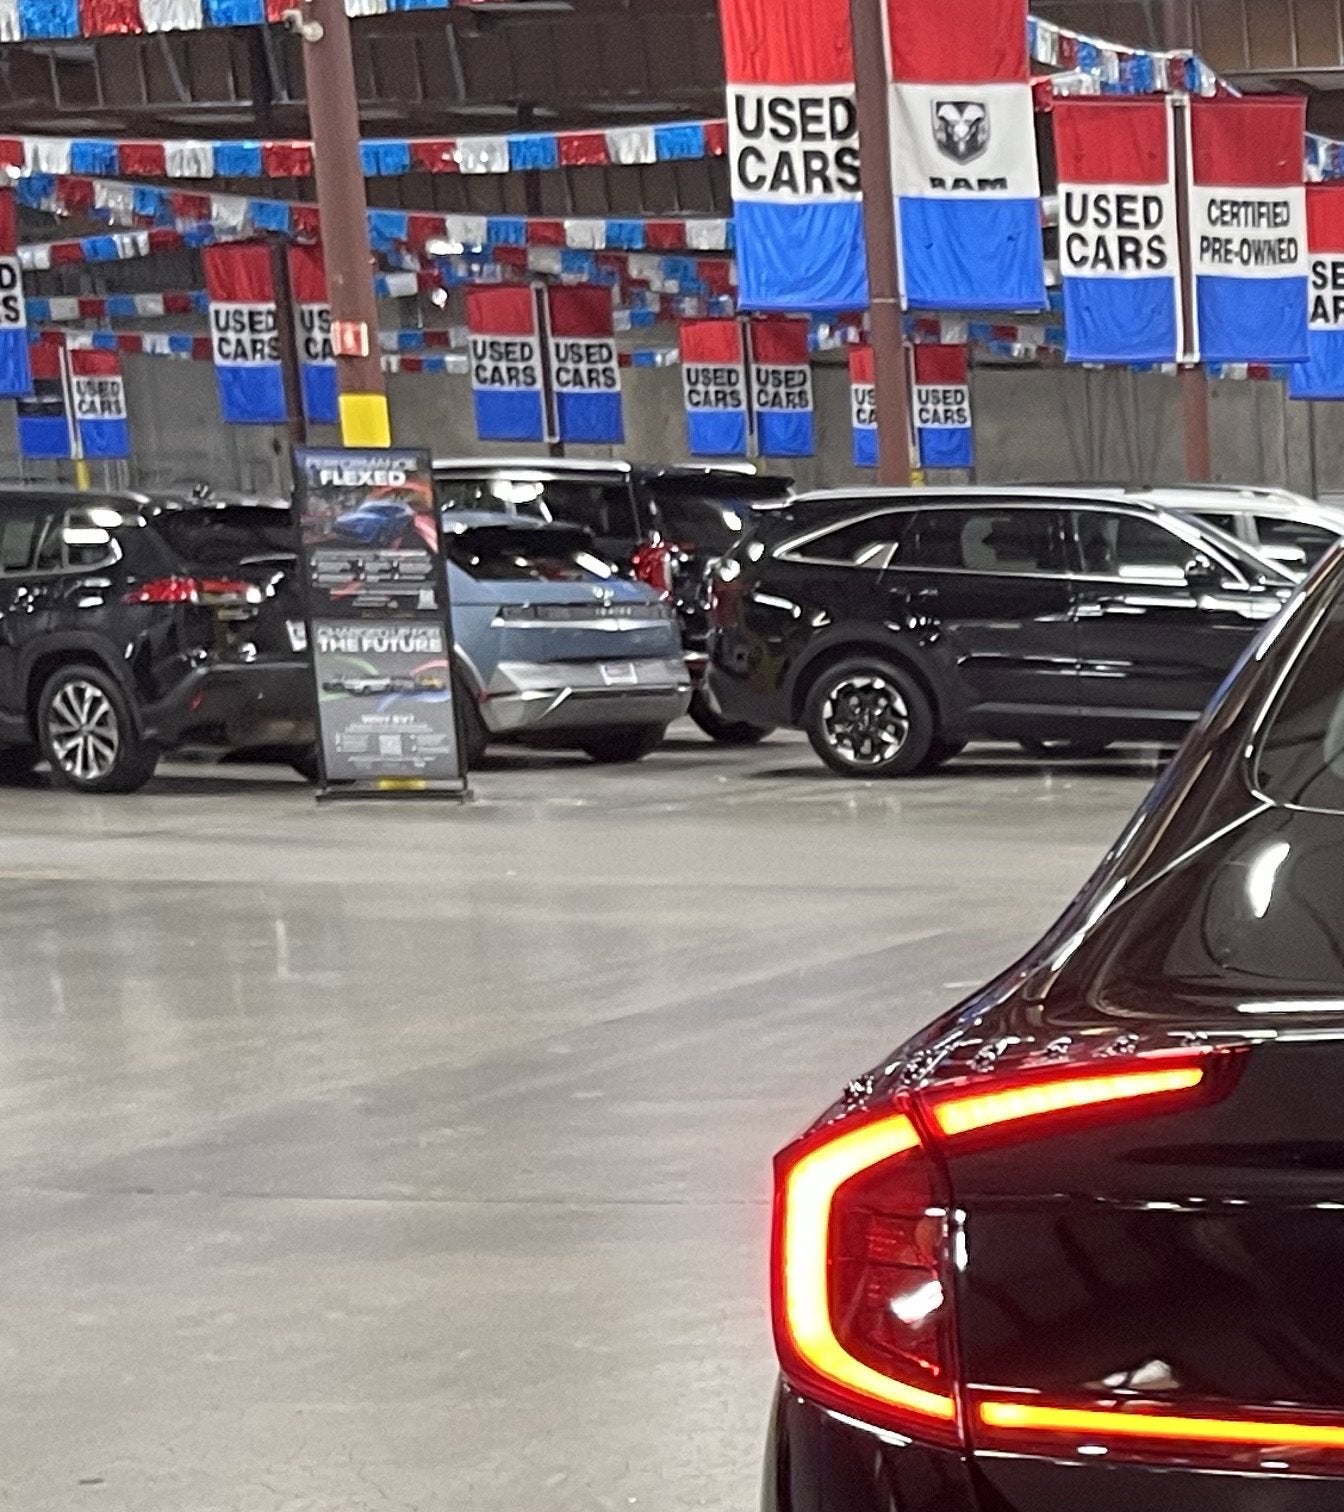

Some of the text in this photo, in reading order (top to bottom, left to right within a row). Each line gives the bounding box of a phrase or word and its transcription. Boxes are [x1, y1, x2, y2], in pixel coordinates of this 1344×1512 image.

[735, 94, 857, 142] USED
[738, 146, 860, 194] CARS
[1065, 192, 1164, 230] USED
[1207, 198, 1290, 228] CERTIFIED
[1066, 232, 1167, 271] CARS
[1199, 236, 1298, 266] PRE-OWNED
[214, 309, 277, 334] USED
[300, 308, 331, 333] US
[218, 337, 281, 361] CARS
[472, 340, 534, 363] USED
[554, 342, 613, 365] USED
[474, 364, 537, 386] CARS
[555, 366, 617, 388] CARS
[686, 368, 740, 387] USED
[756, 368, 808, 389] USED
[688, 388, 742, 408] CARS
[756, 389, 810, 410] CARS
[917, 388, 965, 406] USED
[918, 407, 968, 425] CARS
[320, 470, 406, 486] FLEXED
[317, 638, 442, 652] THE FUTURE
